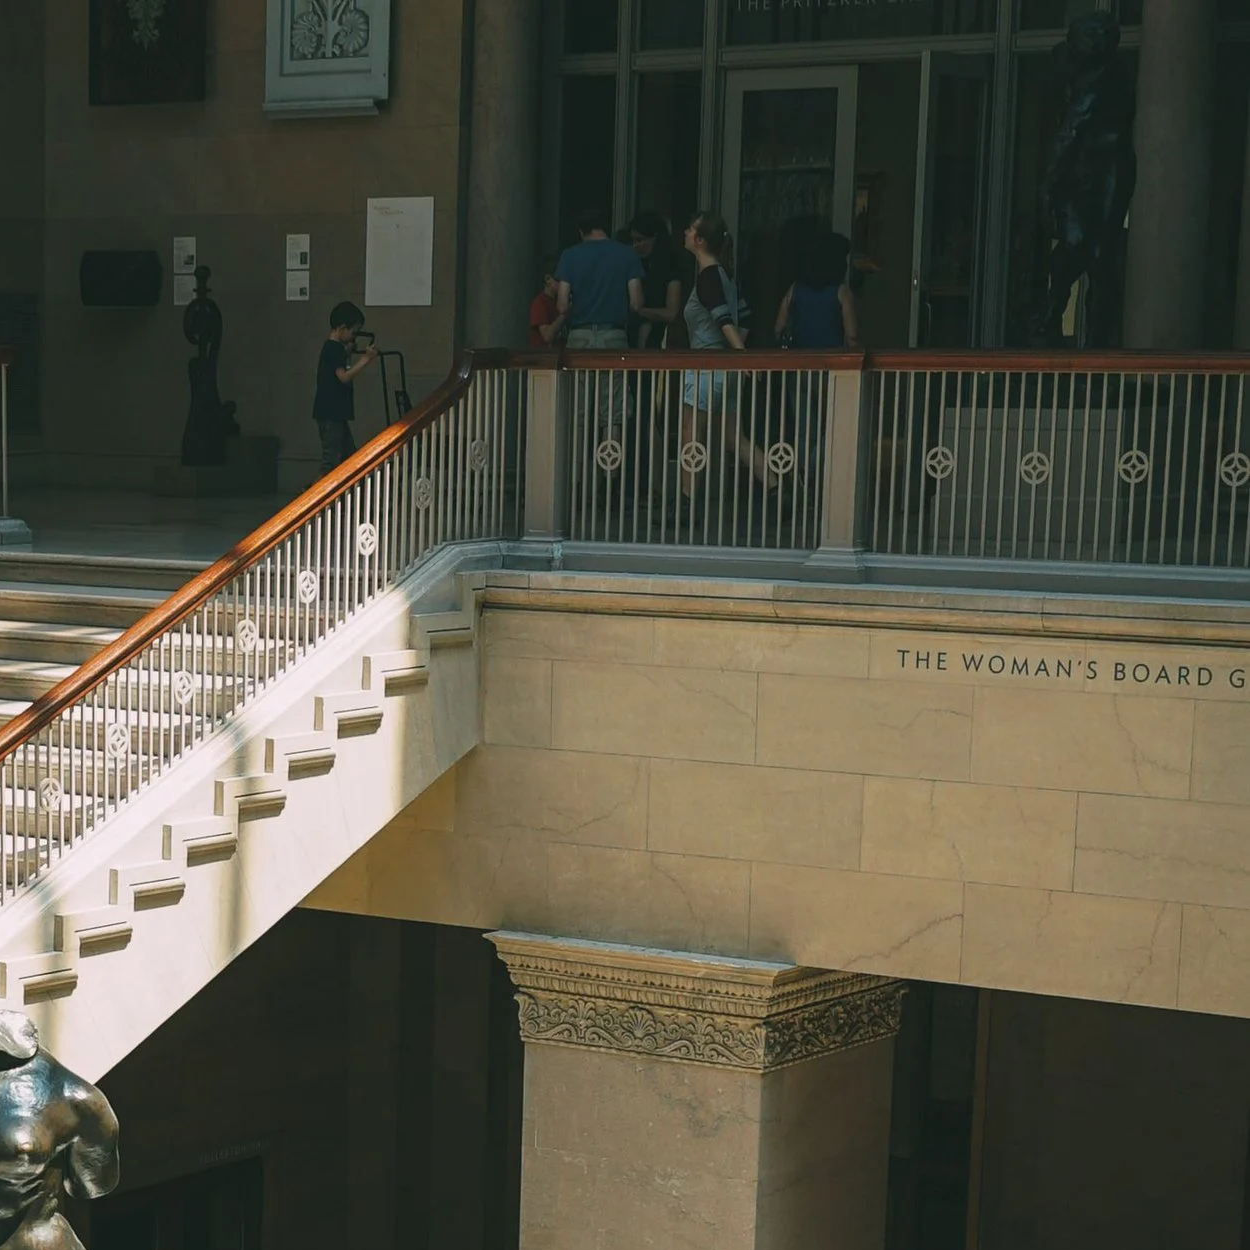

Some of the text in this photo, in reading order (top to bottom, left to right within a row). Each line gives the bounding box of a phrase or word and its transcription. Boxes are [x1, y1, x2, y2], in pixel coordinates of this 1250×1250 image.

[897, 649, 948, 671] THE
[962, 653, 1099, 681] WOMAN'S
[1113, 662, 1214, 687] BOARD
